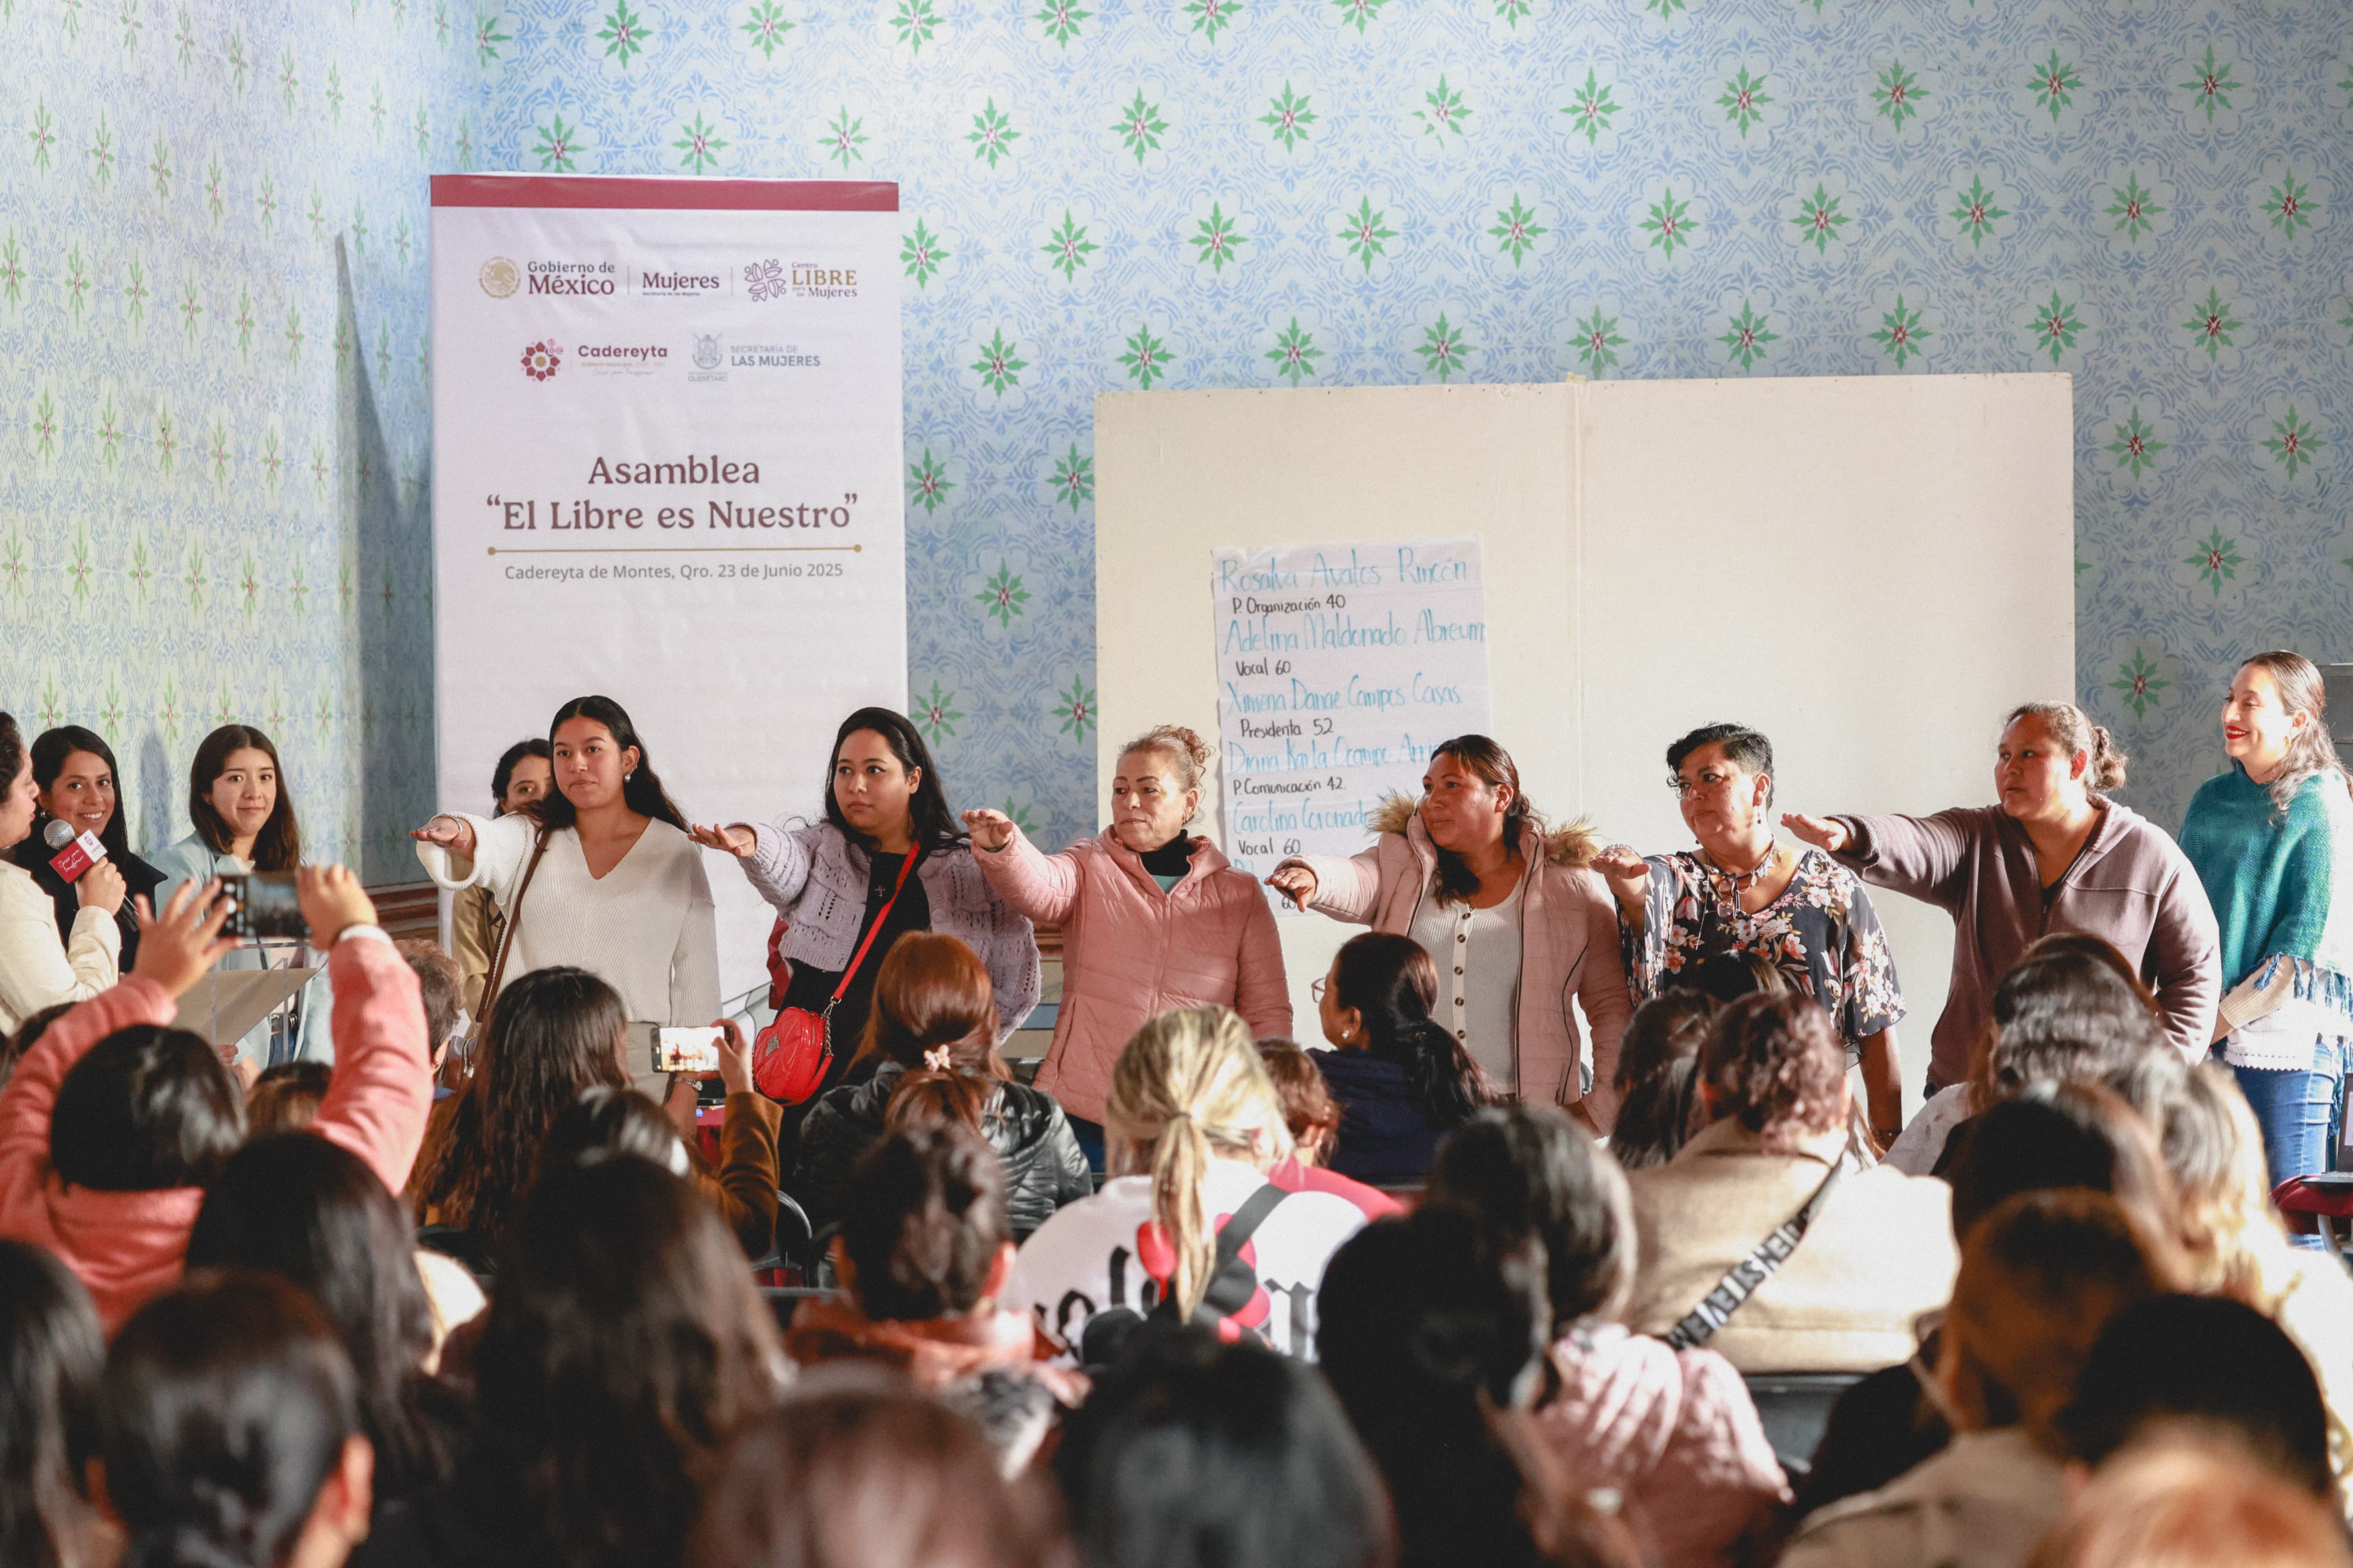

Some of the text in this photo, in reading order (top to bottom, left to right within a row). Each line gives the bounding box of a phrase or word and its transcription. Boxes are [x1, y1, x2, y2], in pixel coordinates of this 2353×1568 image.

[528, 261, 615, 273] Gobierno de
[528, 274, 615, 295] México
[643, 272, 719, 291] Mujeres
[792, 270, 857, 286] LIBRE
[808, 287, 857, 299] Mujeres
[578, 345, 667, 361] Cadereyta
[731, 344, 784, 353] SECRETARÍA
[731, 355, 821, 366] LAS MUJERES
[588, 454, 760, 485] Asamblea
[550, 499, 644, 529] Libre
[657, 507, 695, 529] es
[505, 564, 842, 582] Cadereyta de Montes, Qro. 23 de Junio 2025
[1247, 597, 1321, 617] Organización
[1326, 594, 1346, 609] 40
[1224, 615, 1299, 655] Adelina
[1236, 657, 1269, 676] Vocal
[1240, 718, 1334, 738] Presidenta 52
[1234, 800, 1298, 834] Carolina
[1238, 837, 1301, 856] Vocal 60
